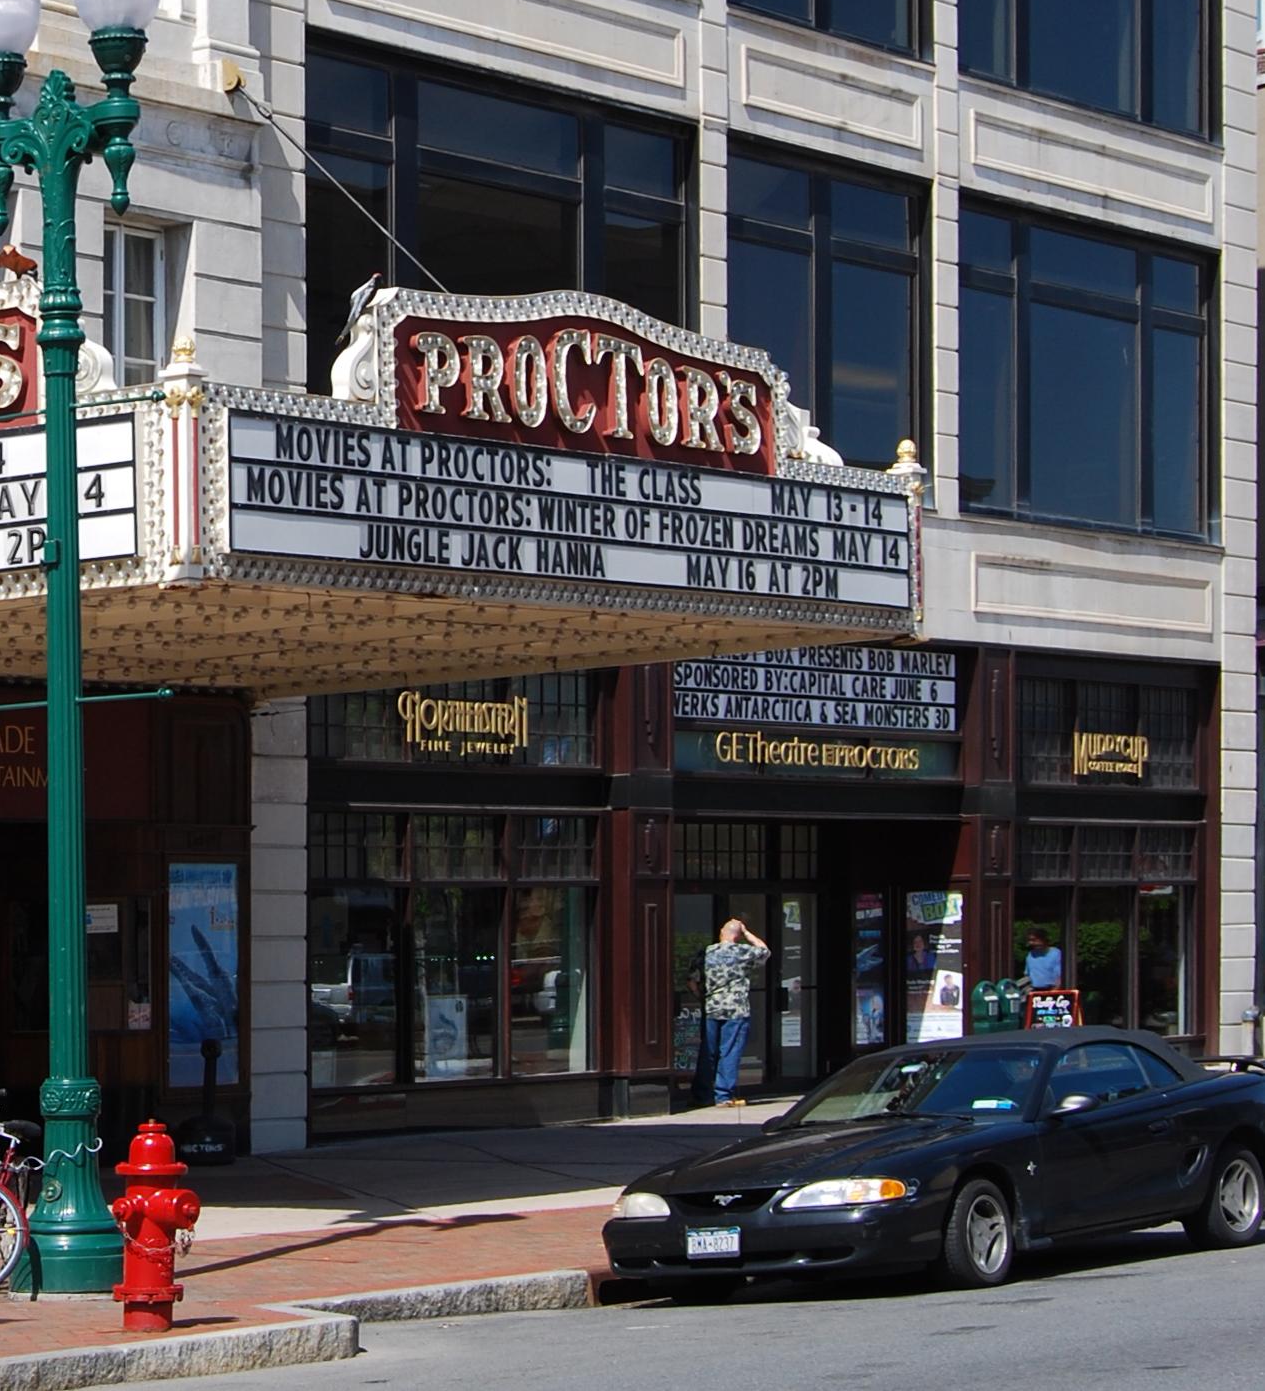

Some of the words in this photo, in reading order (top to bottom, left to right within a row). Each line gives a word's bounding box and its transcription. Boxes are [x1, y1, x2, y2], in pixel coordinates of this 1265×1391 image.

[411, 328, 761, 455] PROCTOR'S
[275, 424, 370, 468] MOVIES
[381, 436, 410, 473] AT
[421, 439, 552, 487] PROCTORS:
[586, 461, 627, 497] THE
[638, 468, 702, 506] CLASS
[771, 483, 812, 517] MAY
[246, 465, 345, 511] MOVIES
[356, 477, 386, 514] AT
[538, 497, 616, 536] WINTER
[625, 509, 651, 540] OF
[659, 511, 735, 549] FROZEN
[743, 521, 820, 558] DREAMS
[833, 530, 873, 563] MAY
[882, 535, 900, 566] 14
[7, 527, 46, 565] 2P
[359, 524, 451, 565] JUNGLE
[461, 533, 523, 570] JACK
[536, 539, 607, 578] HANNA
[686, 554, 730, 589] MAY
[738, 560, 757, 591] 16
[769, 564, 792, 594] AT
[801, 565, 839, 598] 2PM
[798, 646, 864, 671] PRESENTS
[868, 648, 895, 672] BOB
[901, 651, 952, 676] MARLEY
[674, 663, 759, 691] SPONSORED
[852, 675, 886, 699] CARE
[890, 678, 922, 701] JUNE
[929, 682, 938, 702] 6
[723, 695, 813, 723] ANTARCTICA
[819, 702, 828, 724] &
[835, 702, 859, 726] SEA
[864, 705, 930, 729] MONSTERS
[934, 708, 951, 729] 3D
[420, 739, 452, 752] FINE
[460, 741, 515, 756] JEWELRY
